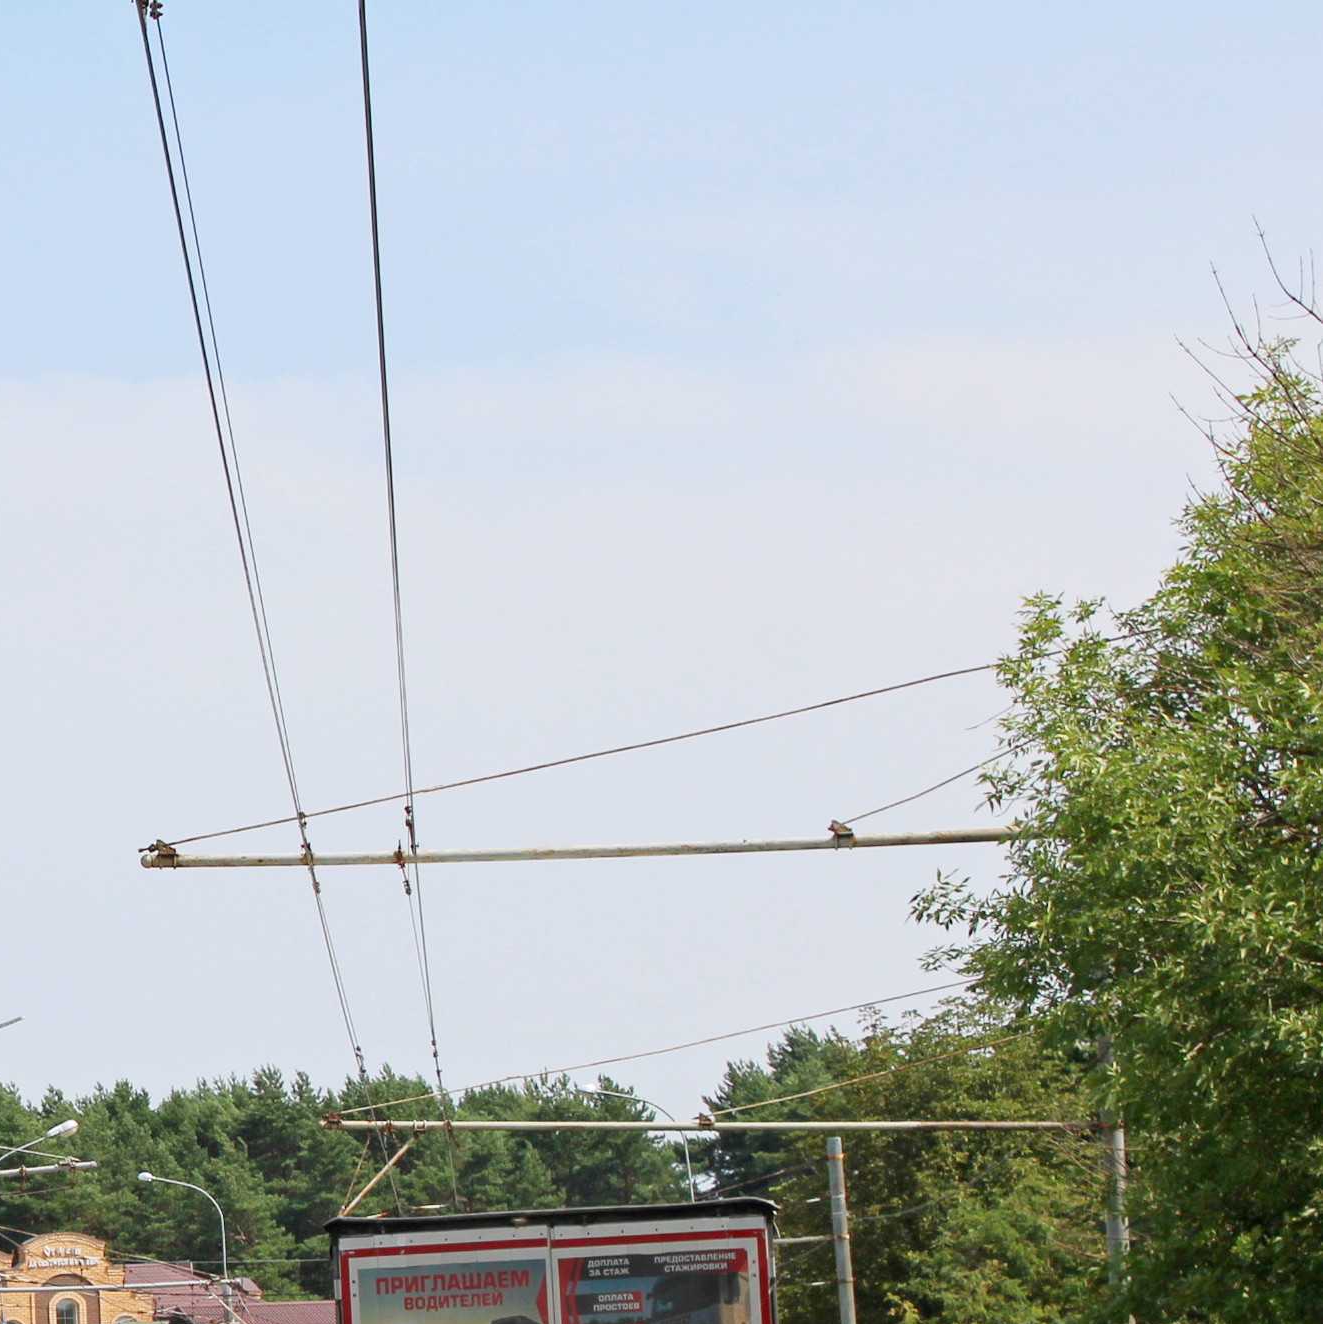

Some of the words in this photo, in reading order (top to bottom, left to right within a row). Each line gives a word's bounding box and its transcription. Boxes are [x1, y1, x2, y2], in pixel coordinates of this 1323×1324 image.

[587, 1257, 630, 1269] ДОПЛАТА
[654, 1251, 737, 1264] ПРЕДОСТАВЛЕНИЕ
[588, 1268, 601, 1277] ЗА
[603, 1267, 630, 1276] СТАЖ
[664, 1262, 729, 1273] СТАЖИРОВКИ
[376, 1270, 530, 1295] ПРИГЛАШАЕМ
[403, 1291, 504, 1312] ВОДИТЕЛЕЙ
[598, 1293, 634, 1303] ОПЛАТА
[593, 1302, 640, 1312] ПРОСТОЕВ
